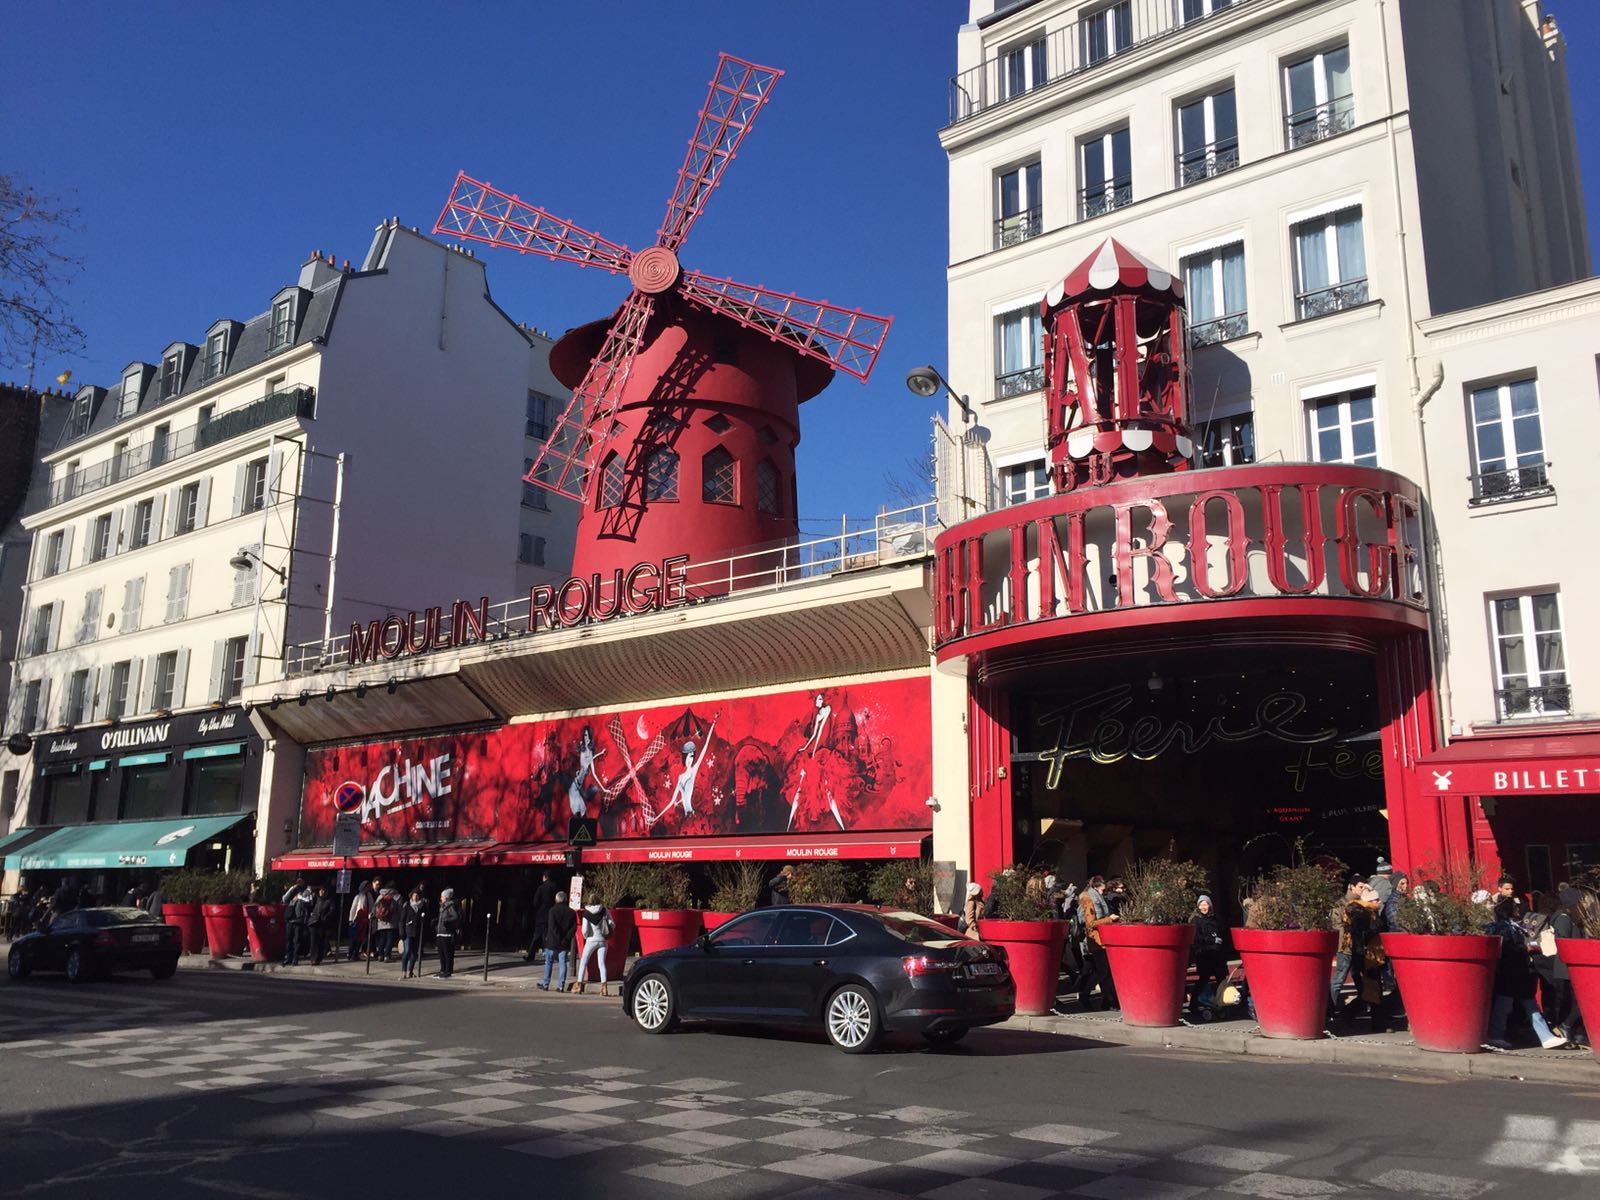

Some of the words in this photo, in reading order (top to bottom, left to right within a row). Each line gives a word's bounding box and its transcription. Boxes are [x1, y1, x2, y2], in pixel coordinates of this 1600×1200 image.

[936, 511, 1089, 643] ULIN
[1114, 484, 1426, 608] ROUGE
[349, 596, 489, 666] MOULIN
[528, 554, 690, 633] ROUGE
[220, 713, 236, 730] Mill
[101, 723, 171, 750] O'SULLIVANS
[355, 753, 452, 824] ACHINE
[552, 853, 566, 861] ROUG
[649, 851, 671, 859] MOULIN
[672, 850, 692, 858] ROUGE
[787, 849, 812, 857] MOULIN
[814, 848, 838, 856] ROUGE
